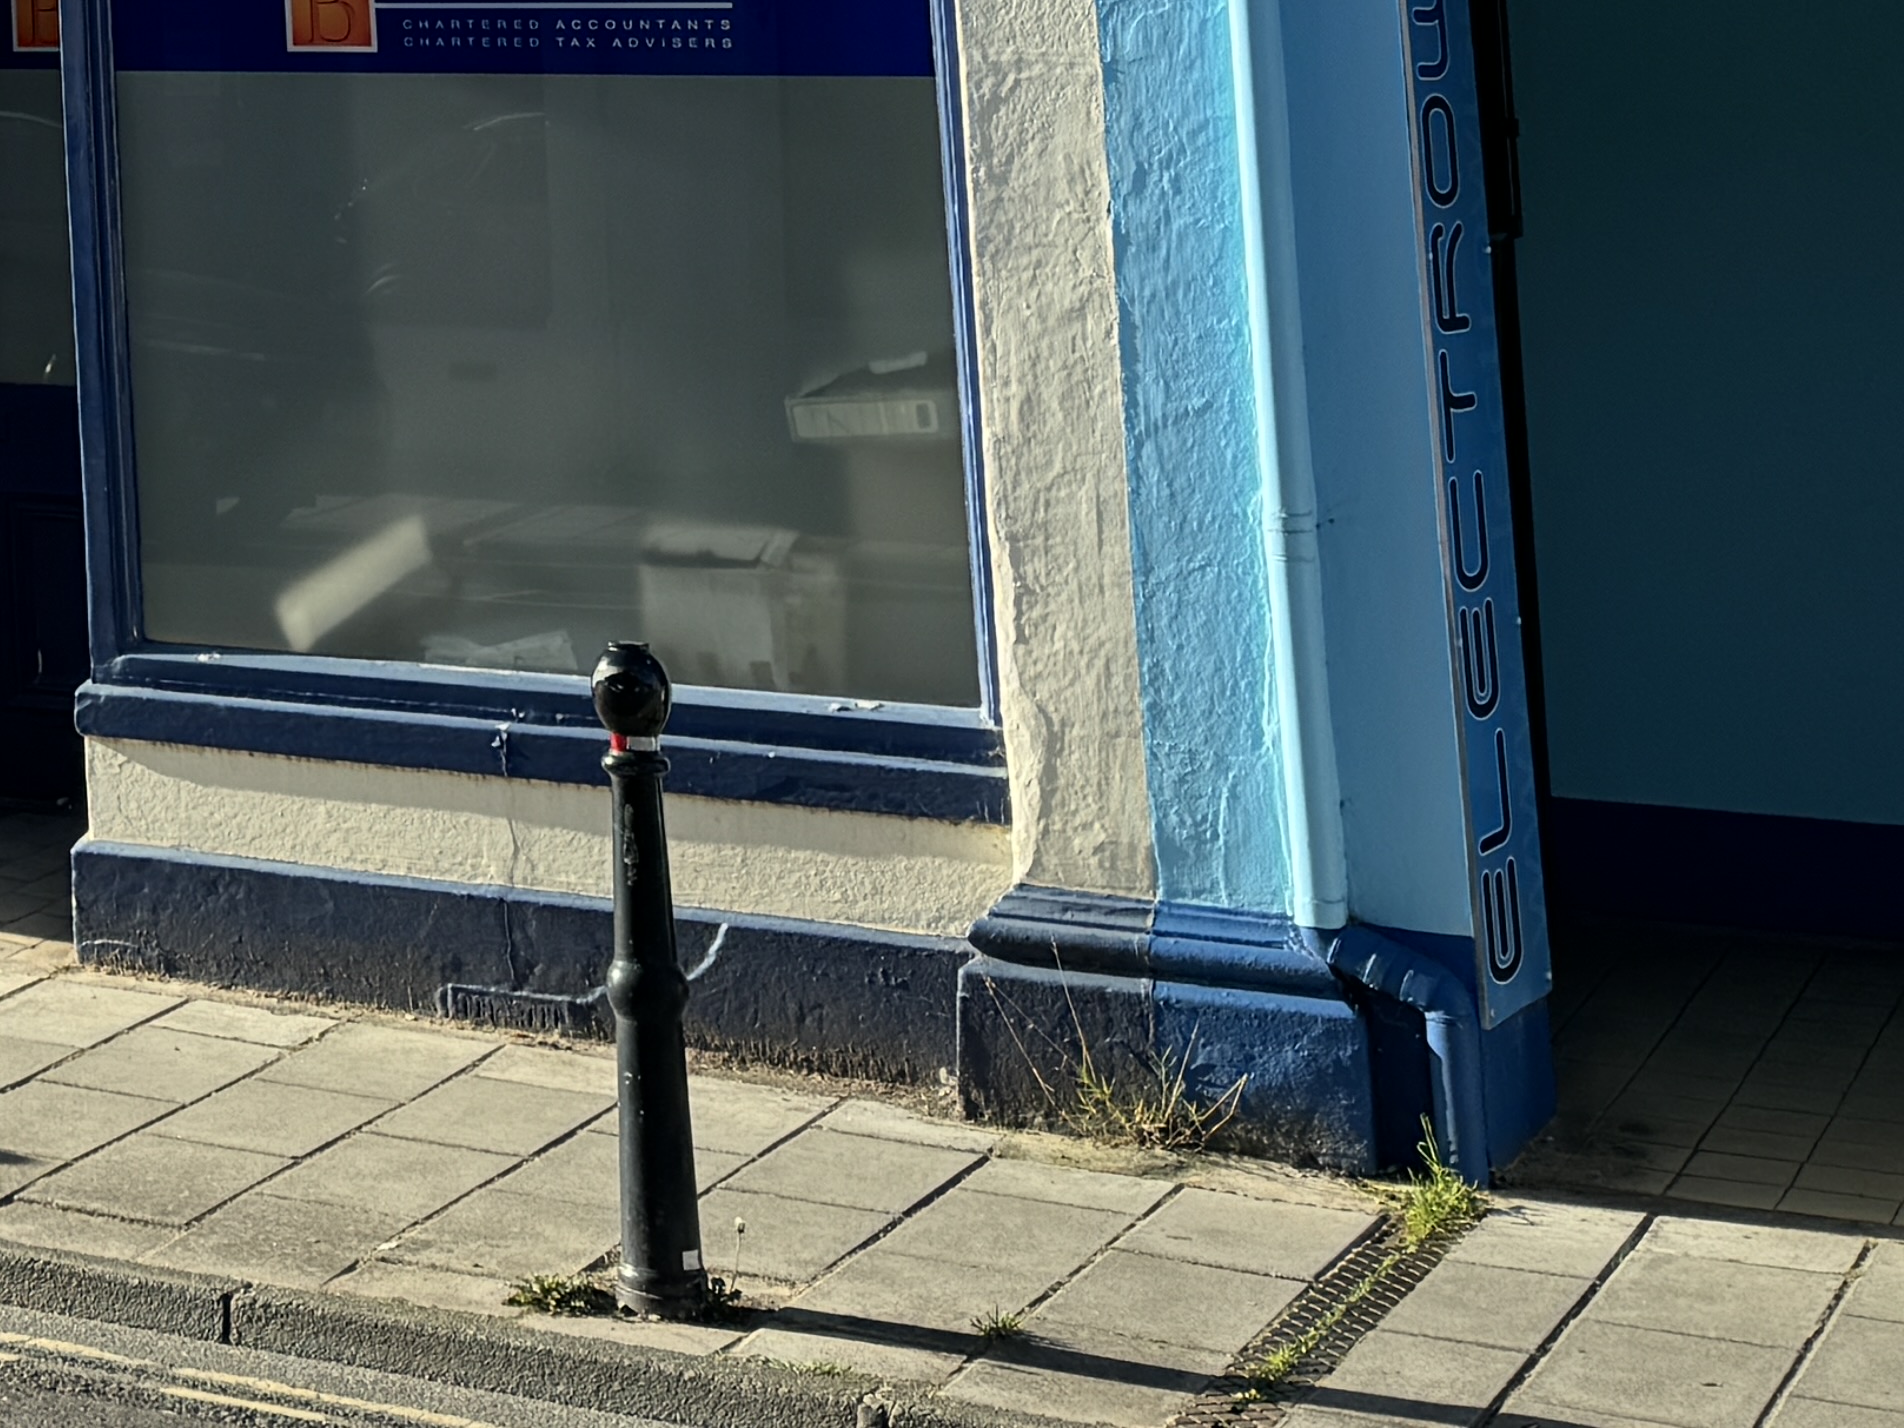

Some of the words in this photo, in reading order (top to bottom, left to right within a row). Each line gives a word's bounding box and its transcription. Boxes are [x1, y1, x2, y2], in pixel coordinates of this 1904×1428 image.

[403, 19, 540, 30] CHARTERED
[556, 19, 732, 30] ACCOUNTANTS
[403, 37, 540, 48] CHARTERED
[555, 37, 596, 48] TAX
[612, 37, 733, 49] ADVISERS
